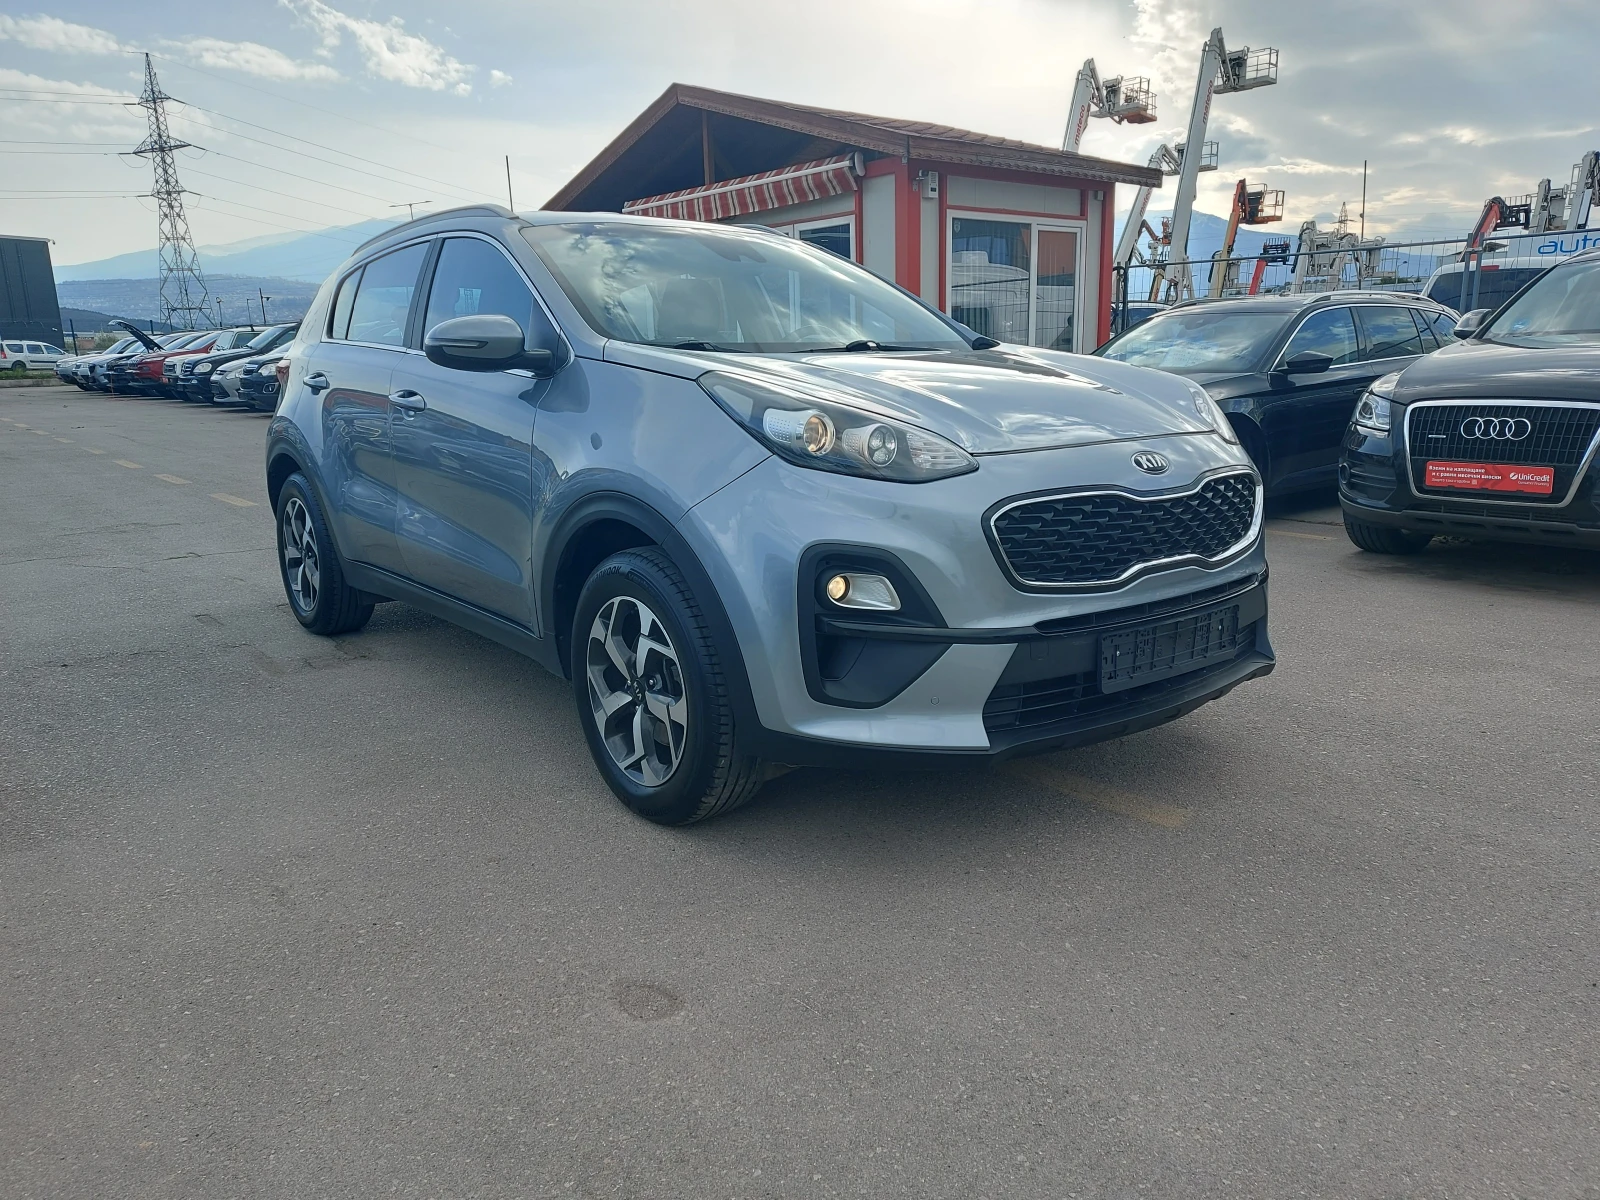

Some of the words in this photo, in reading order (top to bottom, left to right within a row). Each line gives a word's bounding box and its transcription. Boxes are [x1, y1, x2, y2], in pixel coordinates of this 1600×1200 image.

[1202, 79, 1214, 124] mateco
[1074, 104, 1086, 146] mateco
[1136, 454, 1167, 469] KIA
[1518, 473, 1550, 482] UniCredit
